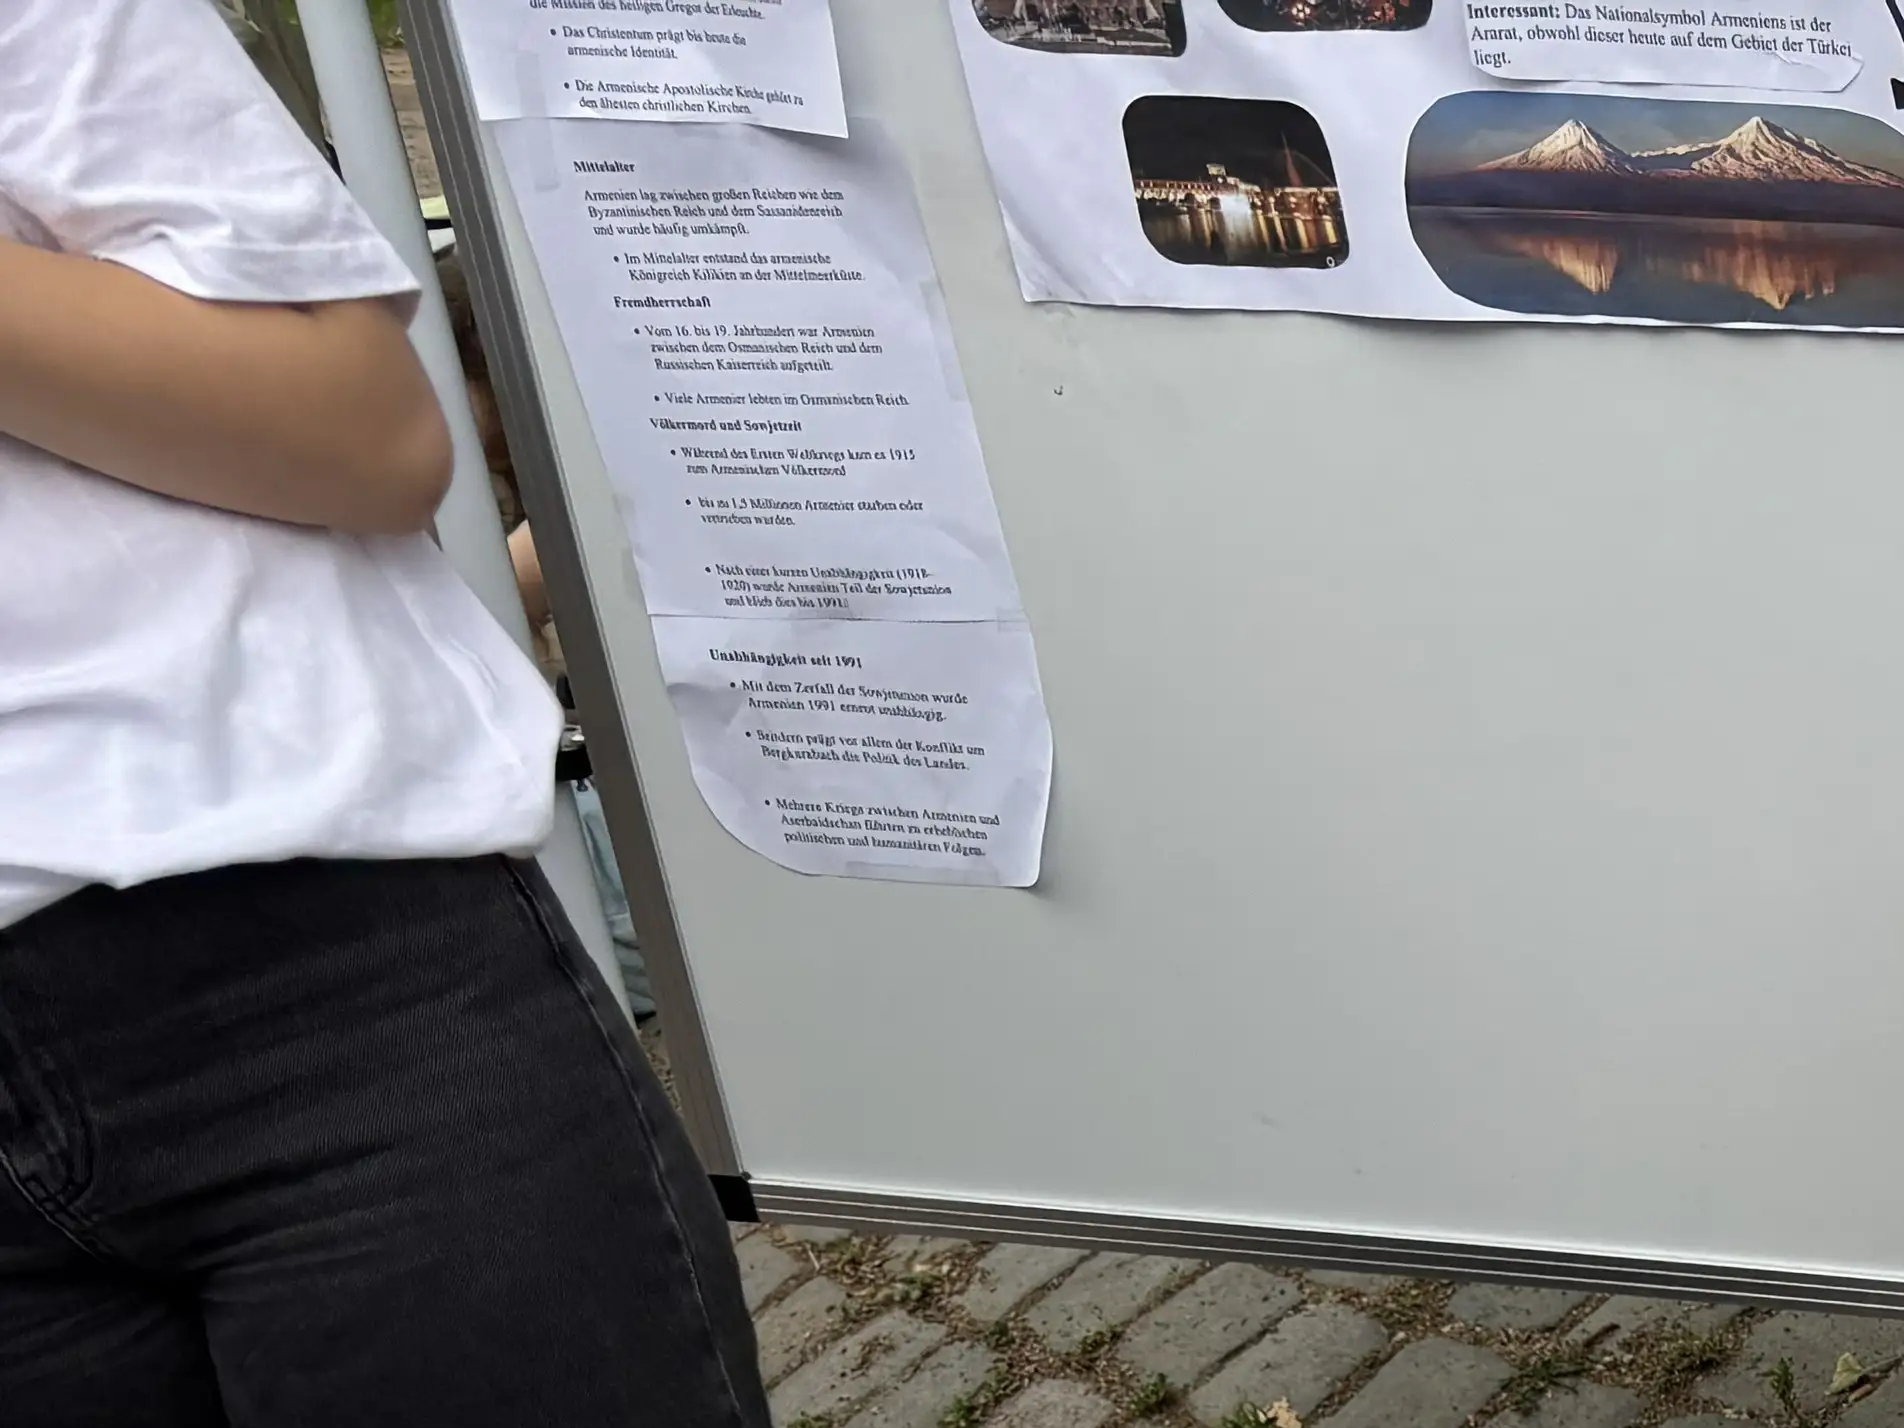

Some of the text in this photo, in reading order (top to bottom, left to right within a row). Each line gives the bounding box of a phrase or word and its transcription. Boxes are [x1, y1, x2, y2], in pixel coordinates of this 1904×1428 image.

[1467, 4, 1831, 32] Interessant: Das Nationalsymbol Armeniens ist der
[1471, 26, 1851, 57] Ararat, obwohl dieser heute auf dem Gebiet der Türkei
[1474, 49, 1511, 70] liegt.
[574, 161, 635, 173] Mittelalter
[614, 296, 711, 308] Fremdherrschaft
